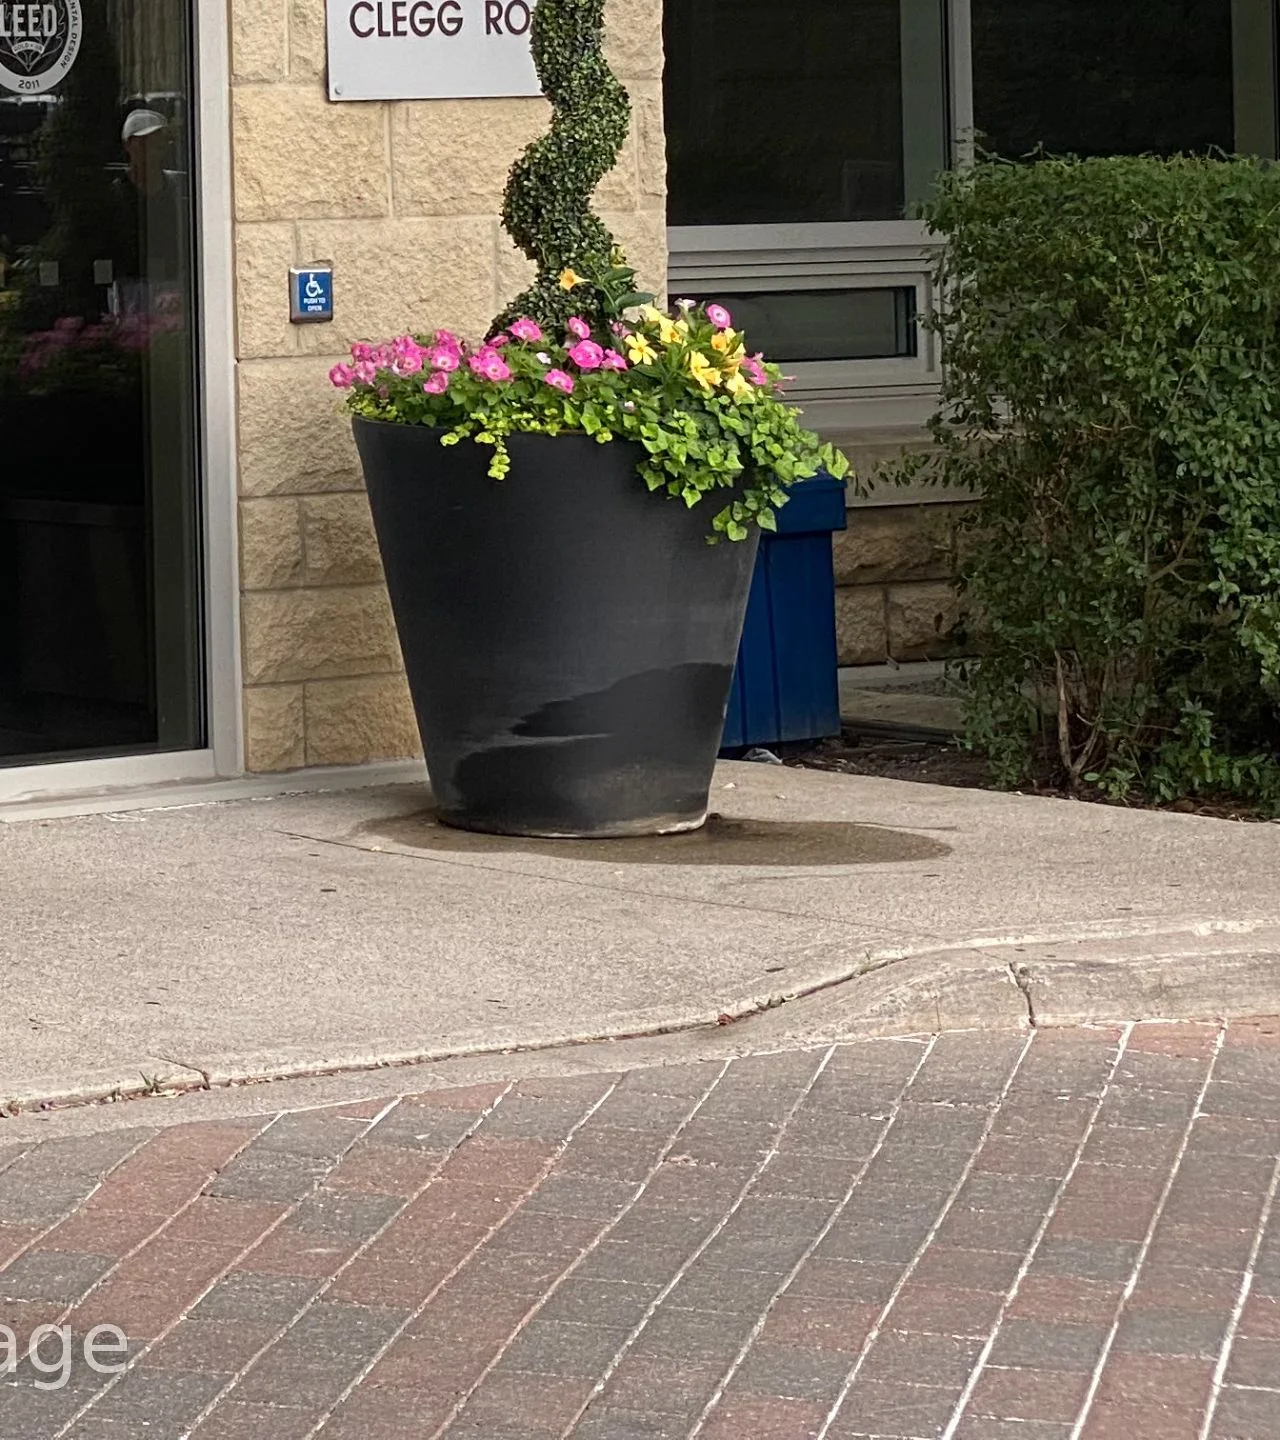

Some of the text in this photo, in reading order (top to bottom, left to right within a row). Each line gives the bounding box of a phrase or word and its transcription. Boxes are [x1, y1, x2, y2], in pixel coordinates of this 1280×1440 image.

[0, 4, 58, 37] LEED
[349, 0, 531, 38] CLEGG RO
[61, 33, 77, 68] DESIGN
[18, 79, 40, 89] 2011
